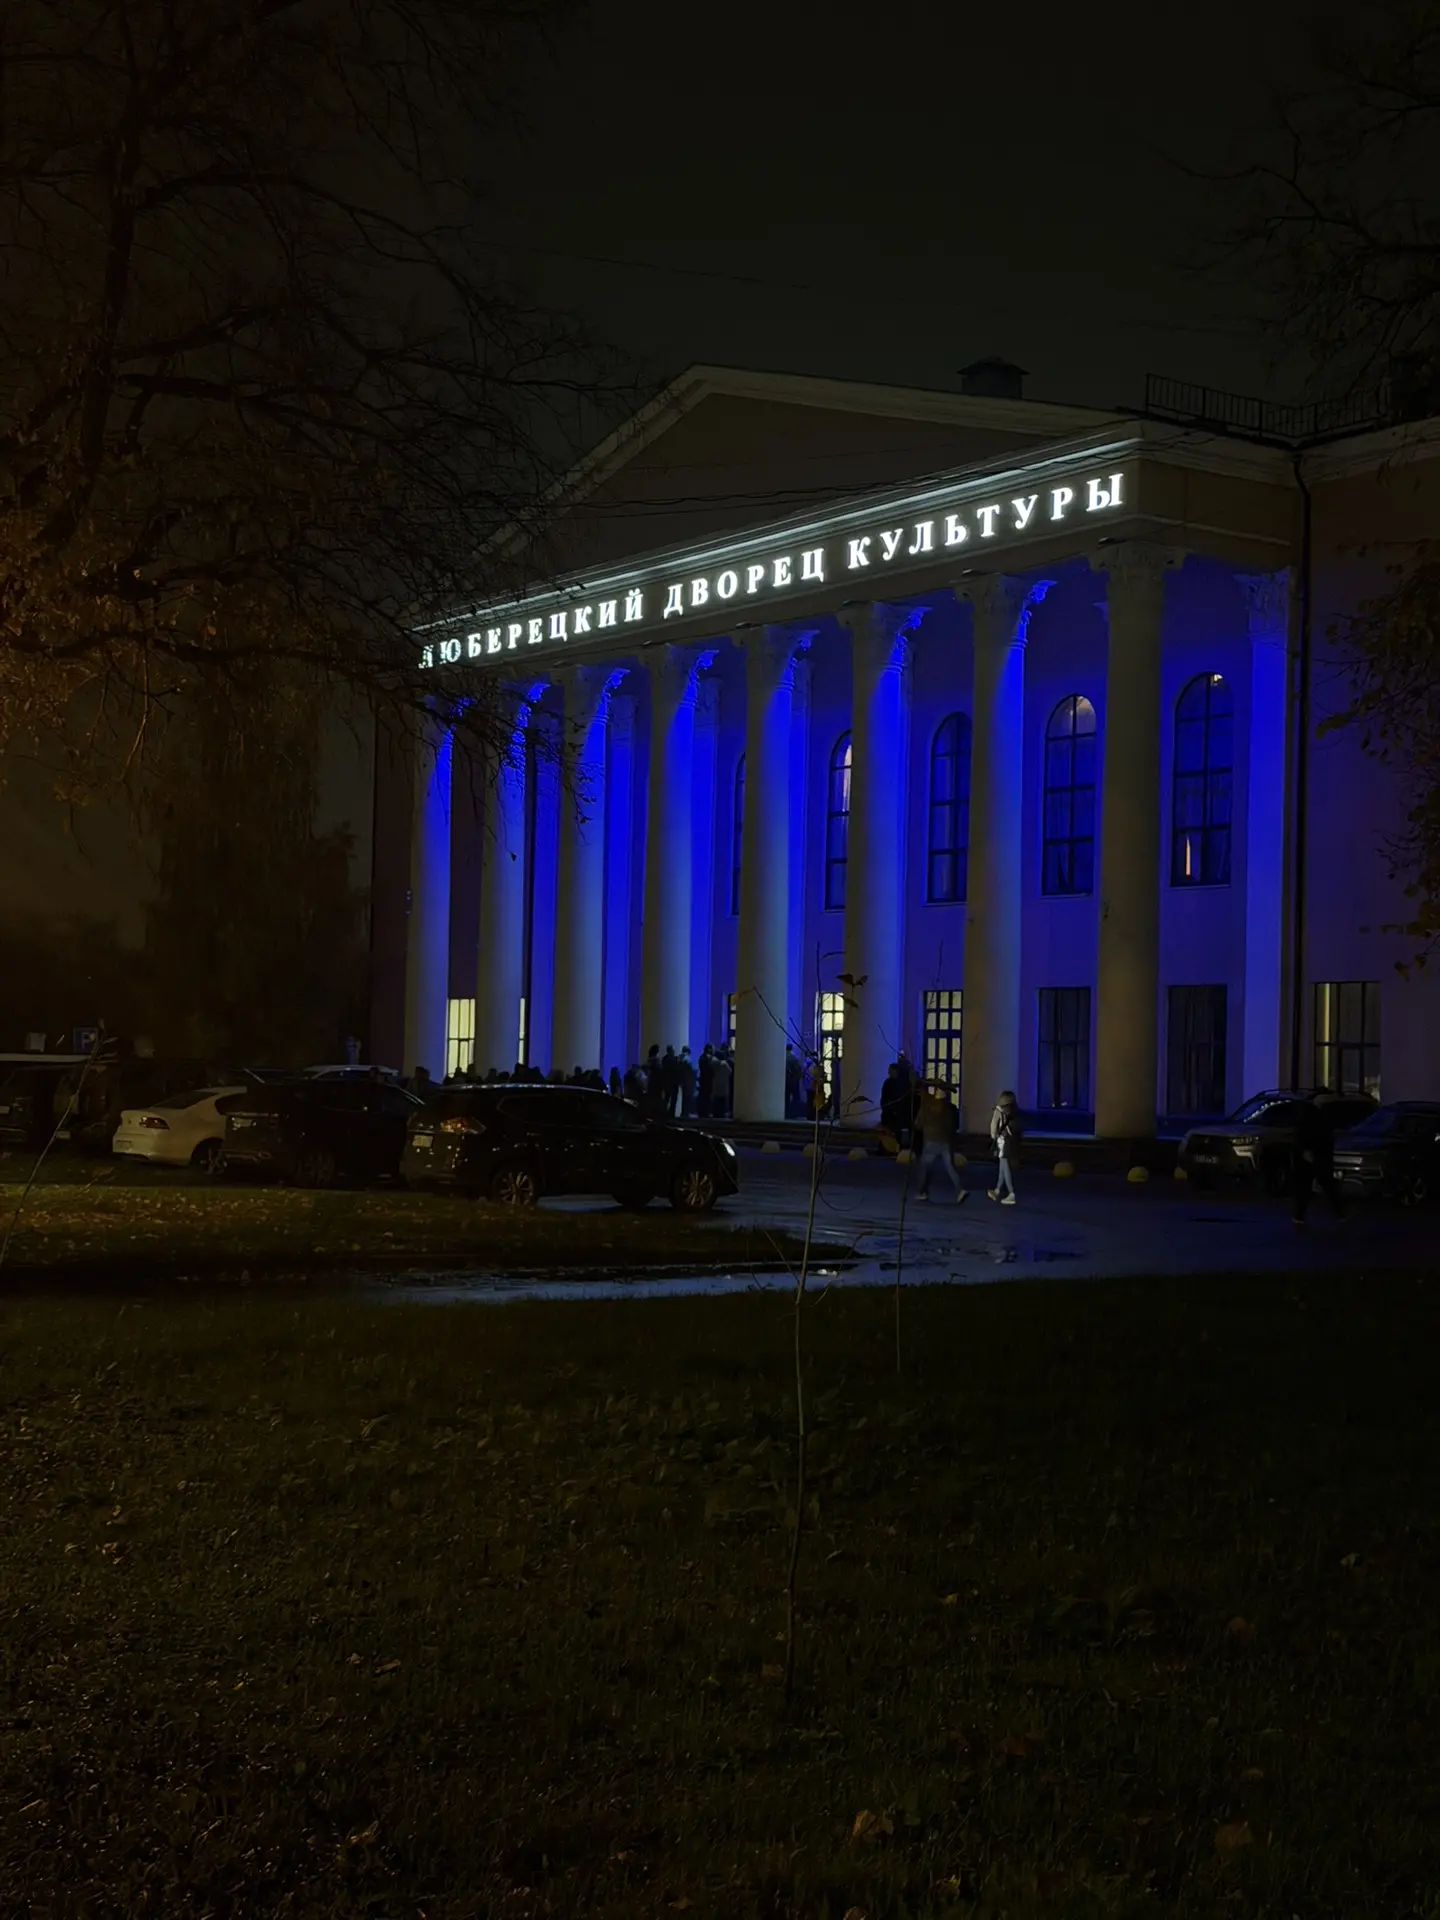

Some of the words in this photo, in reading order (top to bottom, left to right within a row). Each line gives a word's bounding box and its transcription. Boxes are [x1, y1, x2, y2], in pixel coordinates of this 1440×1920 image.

[418, 587, 644, 669] ЛЮБЕРЕЦКИЙ
[663, 547, 825, 619] ДВОРЕЦ
[847, 472, 1124, 570] КУЛЬТУРЫ
